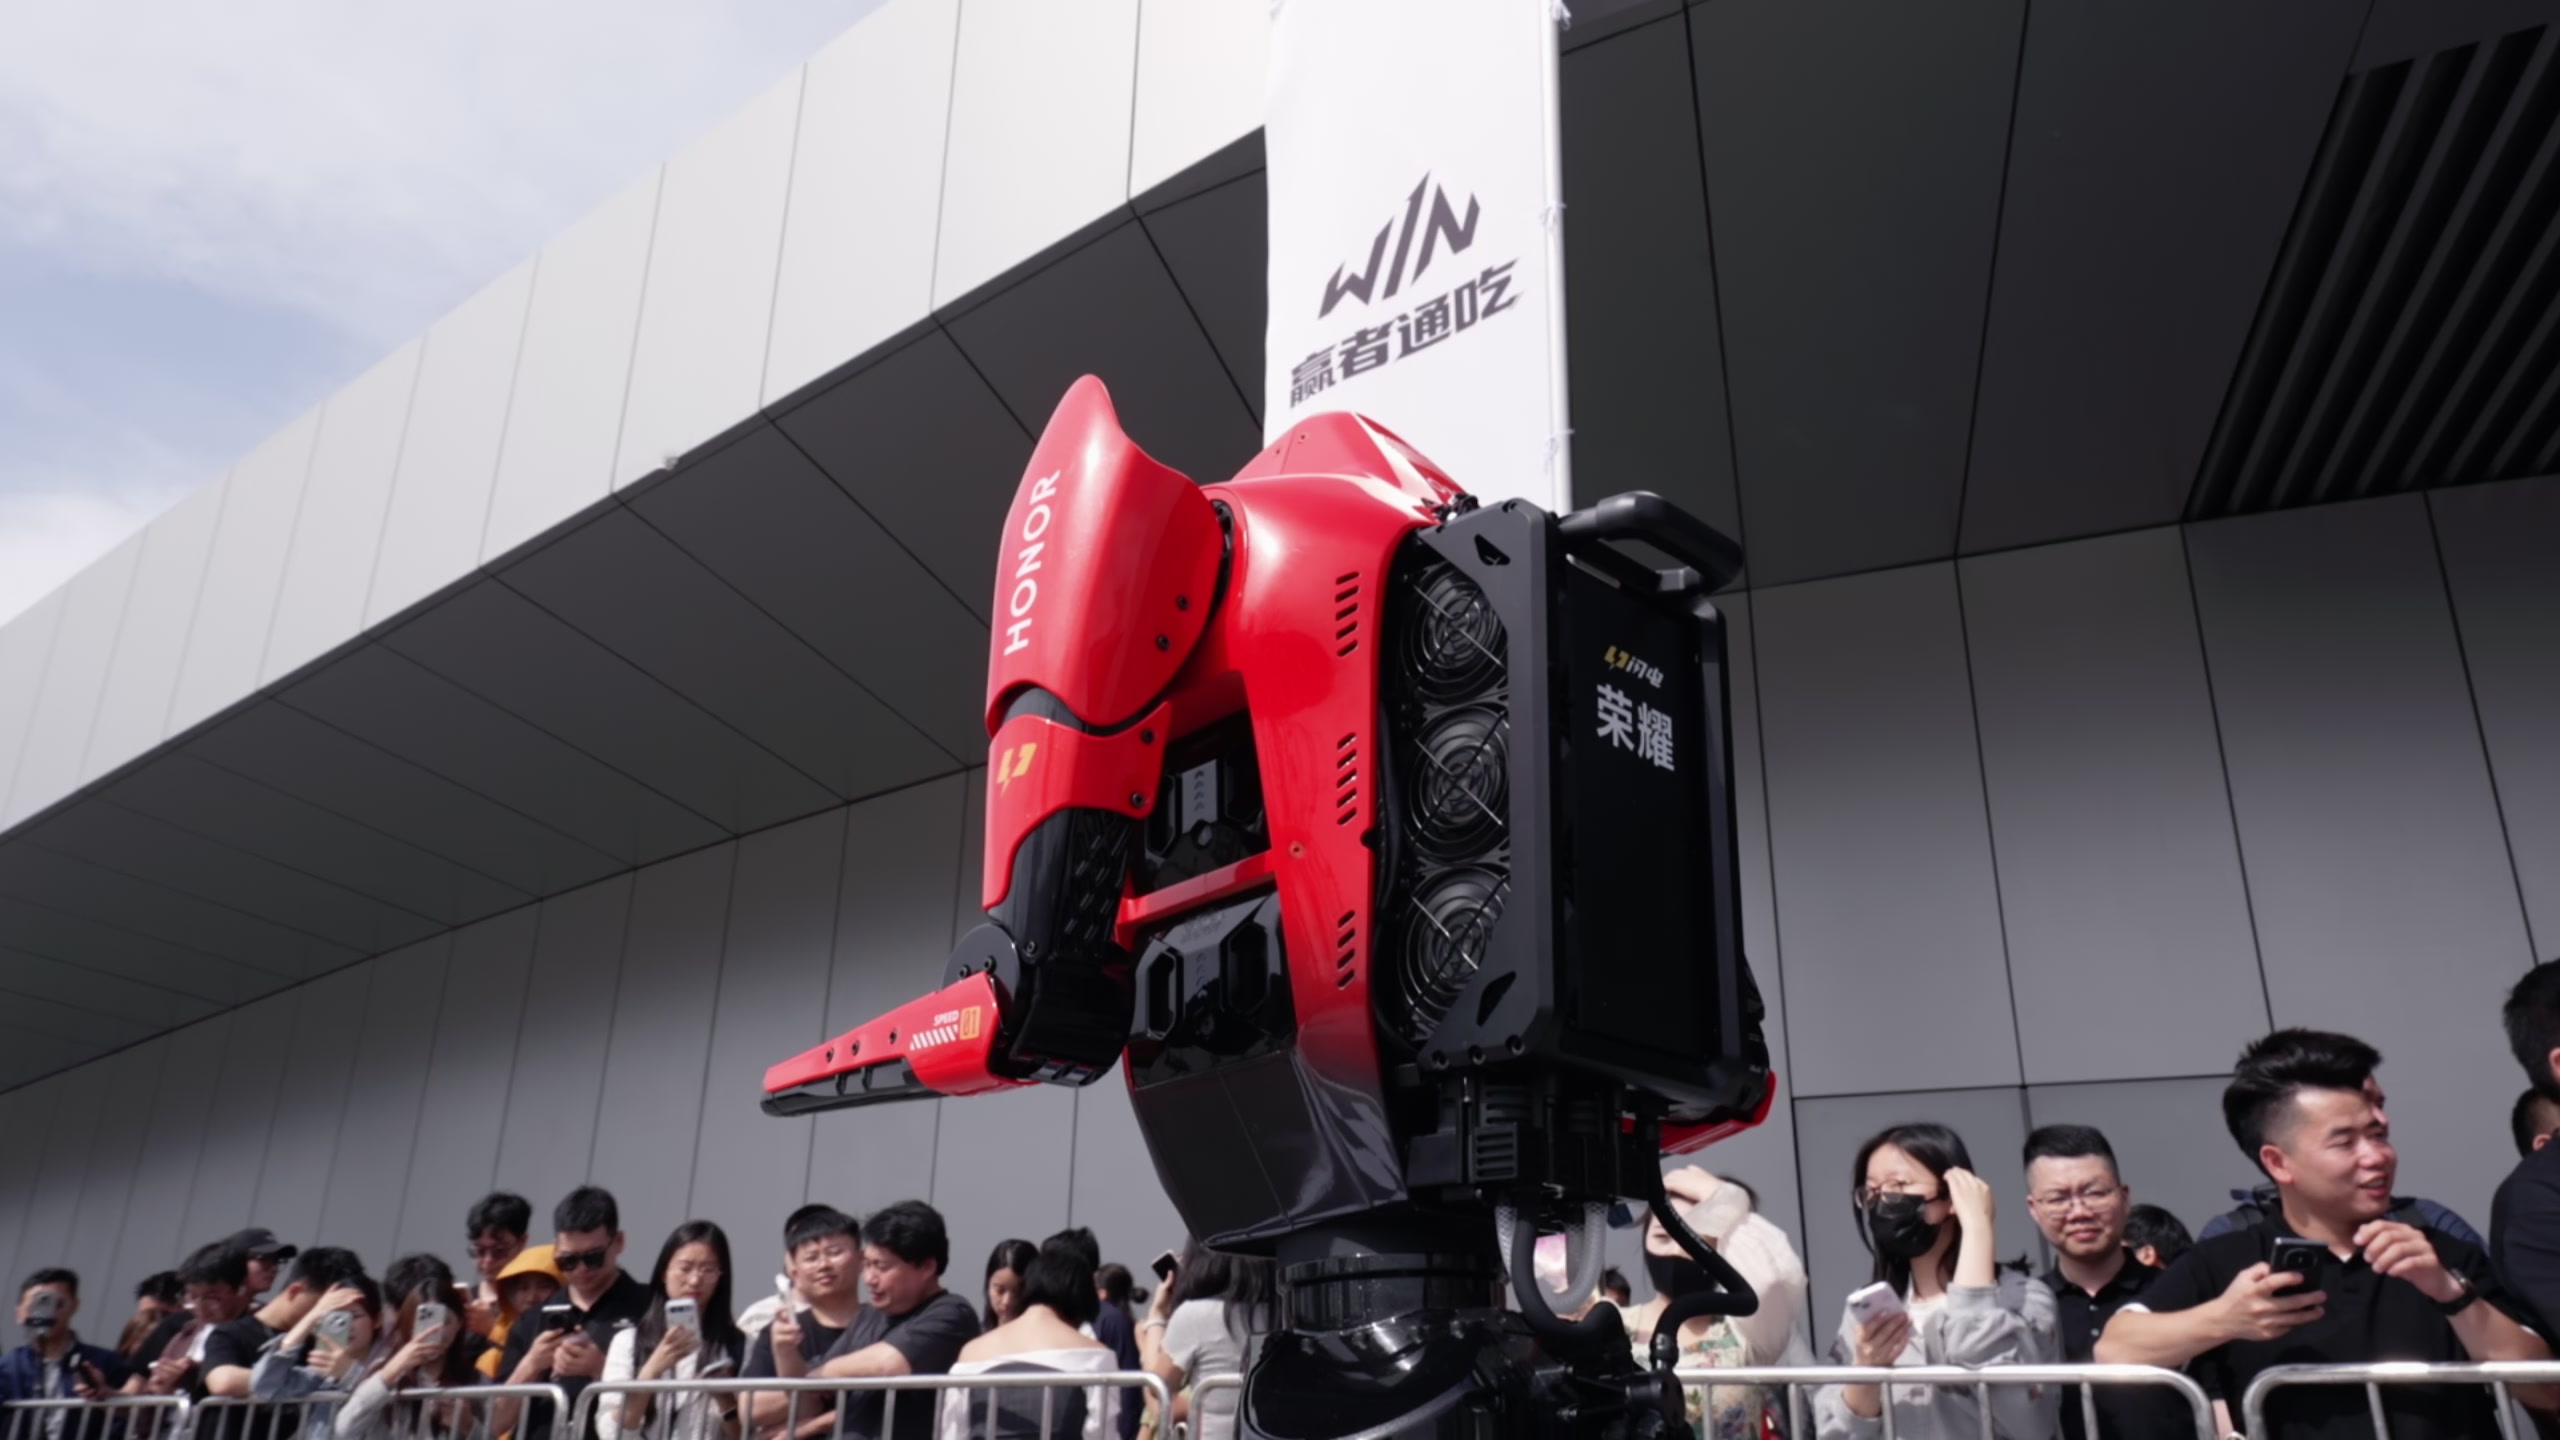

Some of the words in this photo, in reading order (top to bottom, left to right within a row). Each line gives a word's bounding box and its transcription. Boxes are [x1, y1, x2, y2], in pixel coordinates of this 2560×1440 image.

[1318, 169, 1480, 319] WIN
[1290, 257, 1524, 408] 赢者通吃
[1003, 469, 1061, 656] HONOR
[1597, 683, 1675, 772] 荣耀
[1626, 656, 1664, 688] 闪电
[934, 1010, 960, 1027] SPEED
